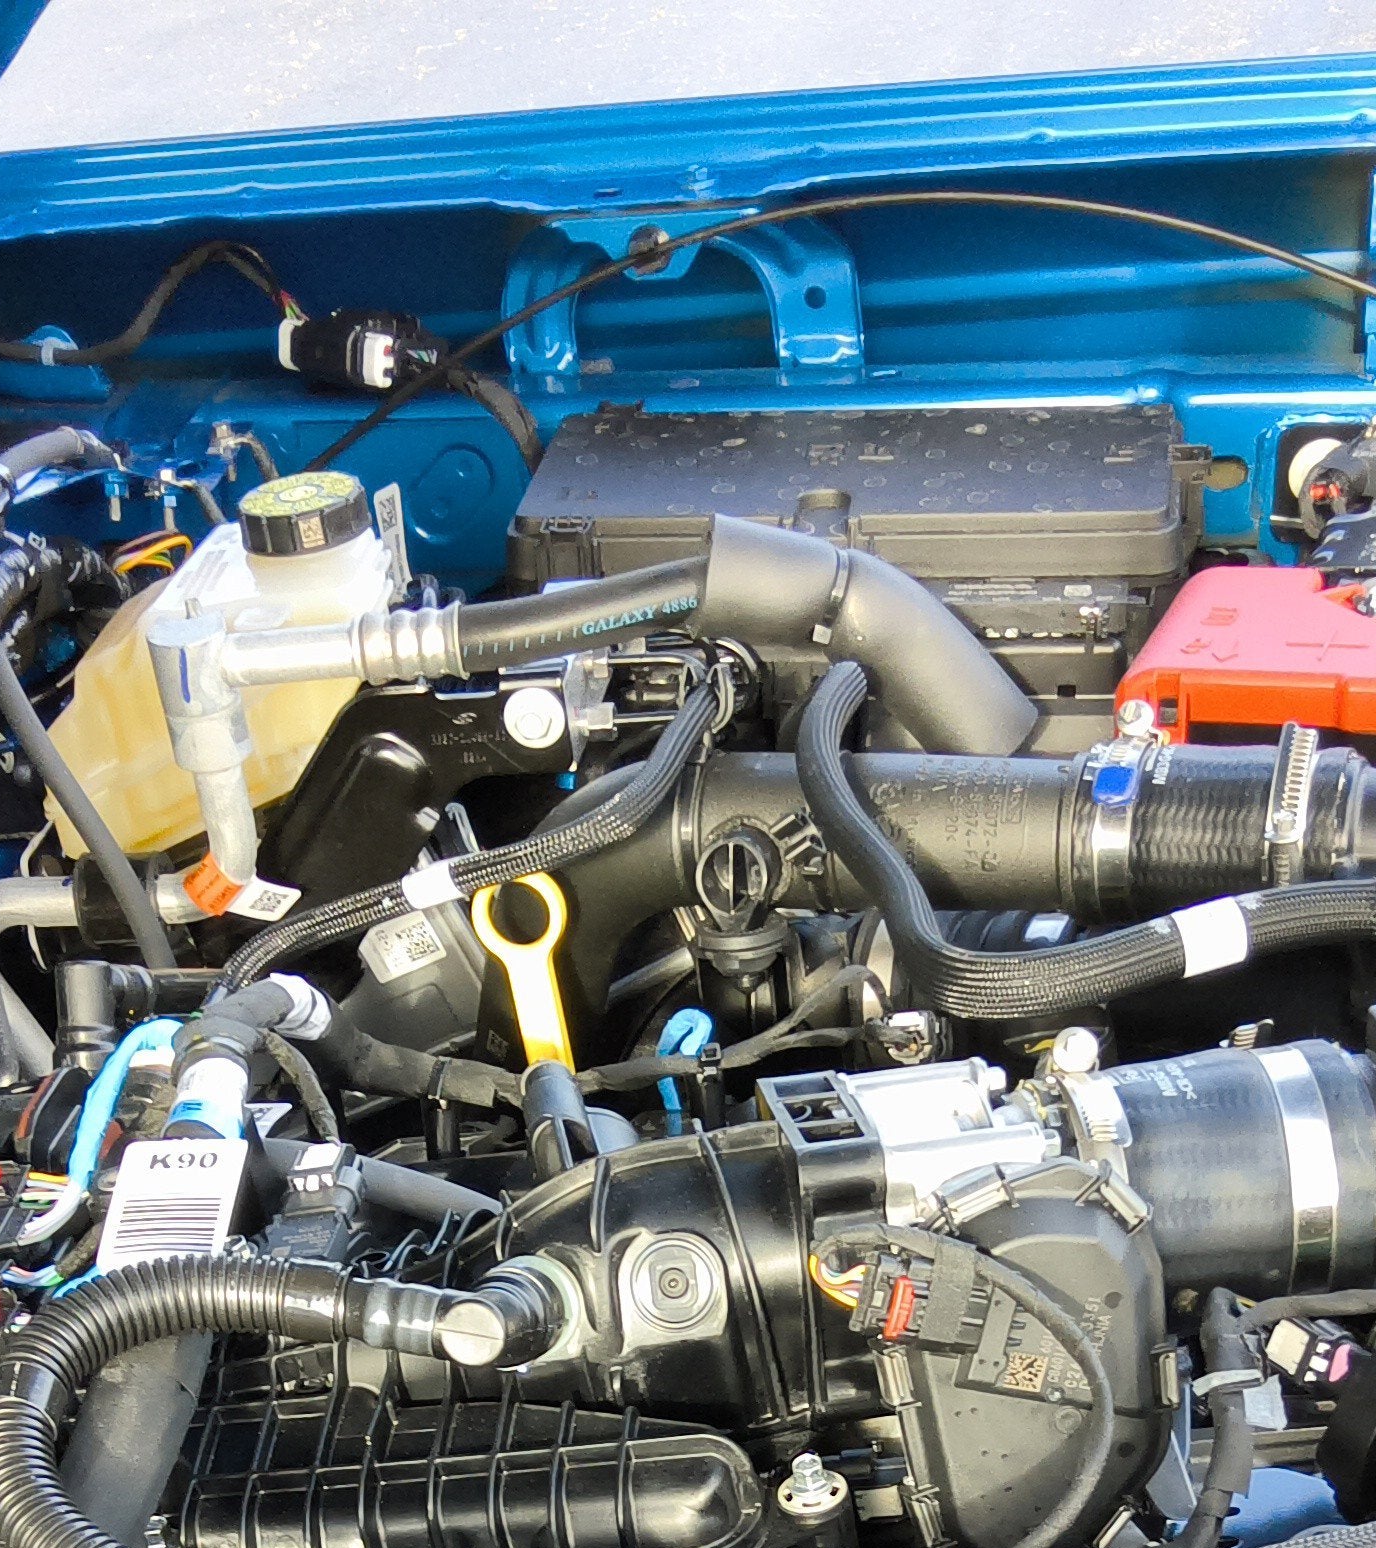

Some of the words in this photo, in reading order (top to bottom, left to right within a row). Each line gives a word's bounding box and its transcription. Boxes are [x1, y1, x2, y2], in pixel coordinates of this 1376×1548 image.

[581, 604, 657, 636] GALAXY
[661, 595, 698, 614] 4886
[149, 1152, 218, 1170] K90
